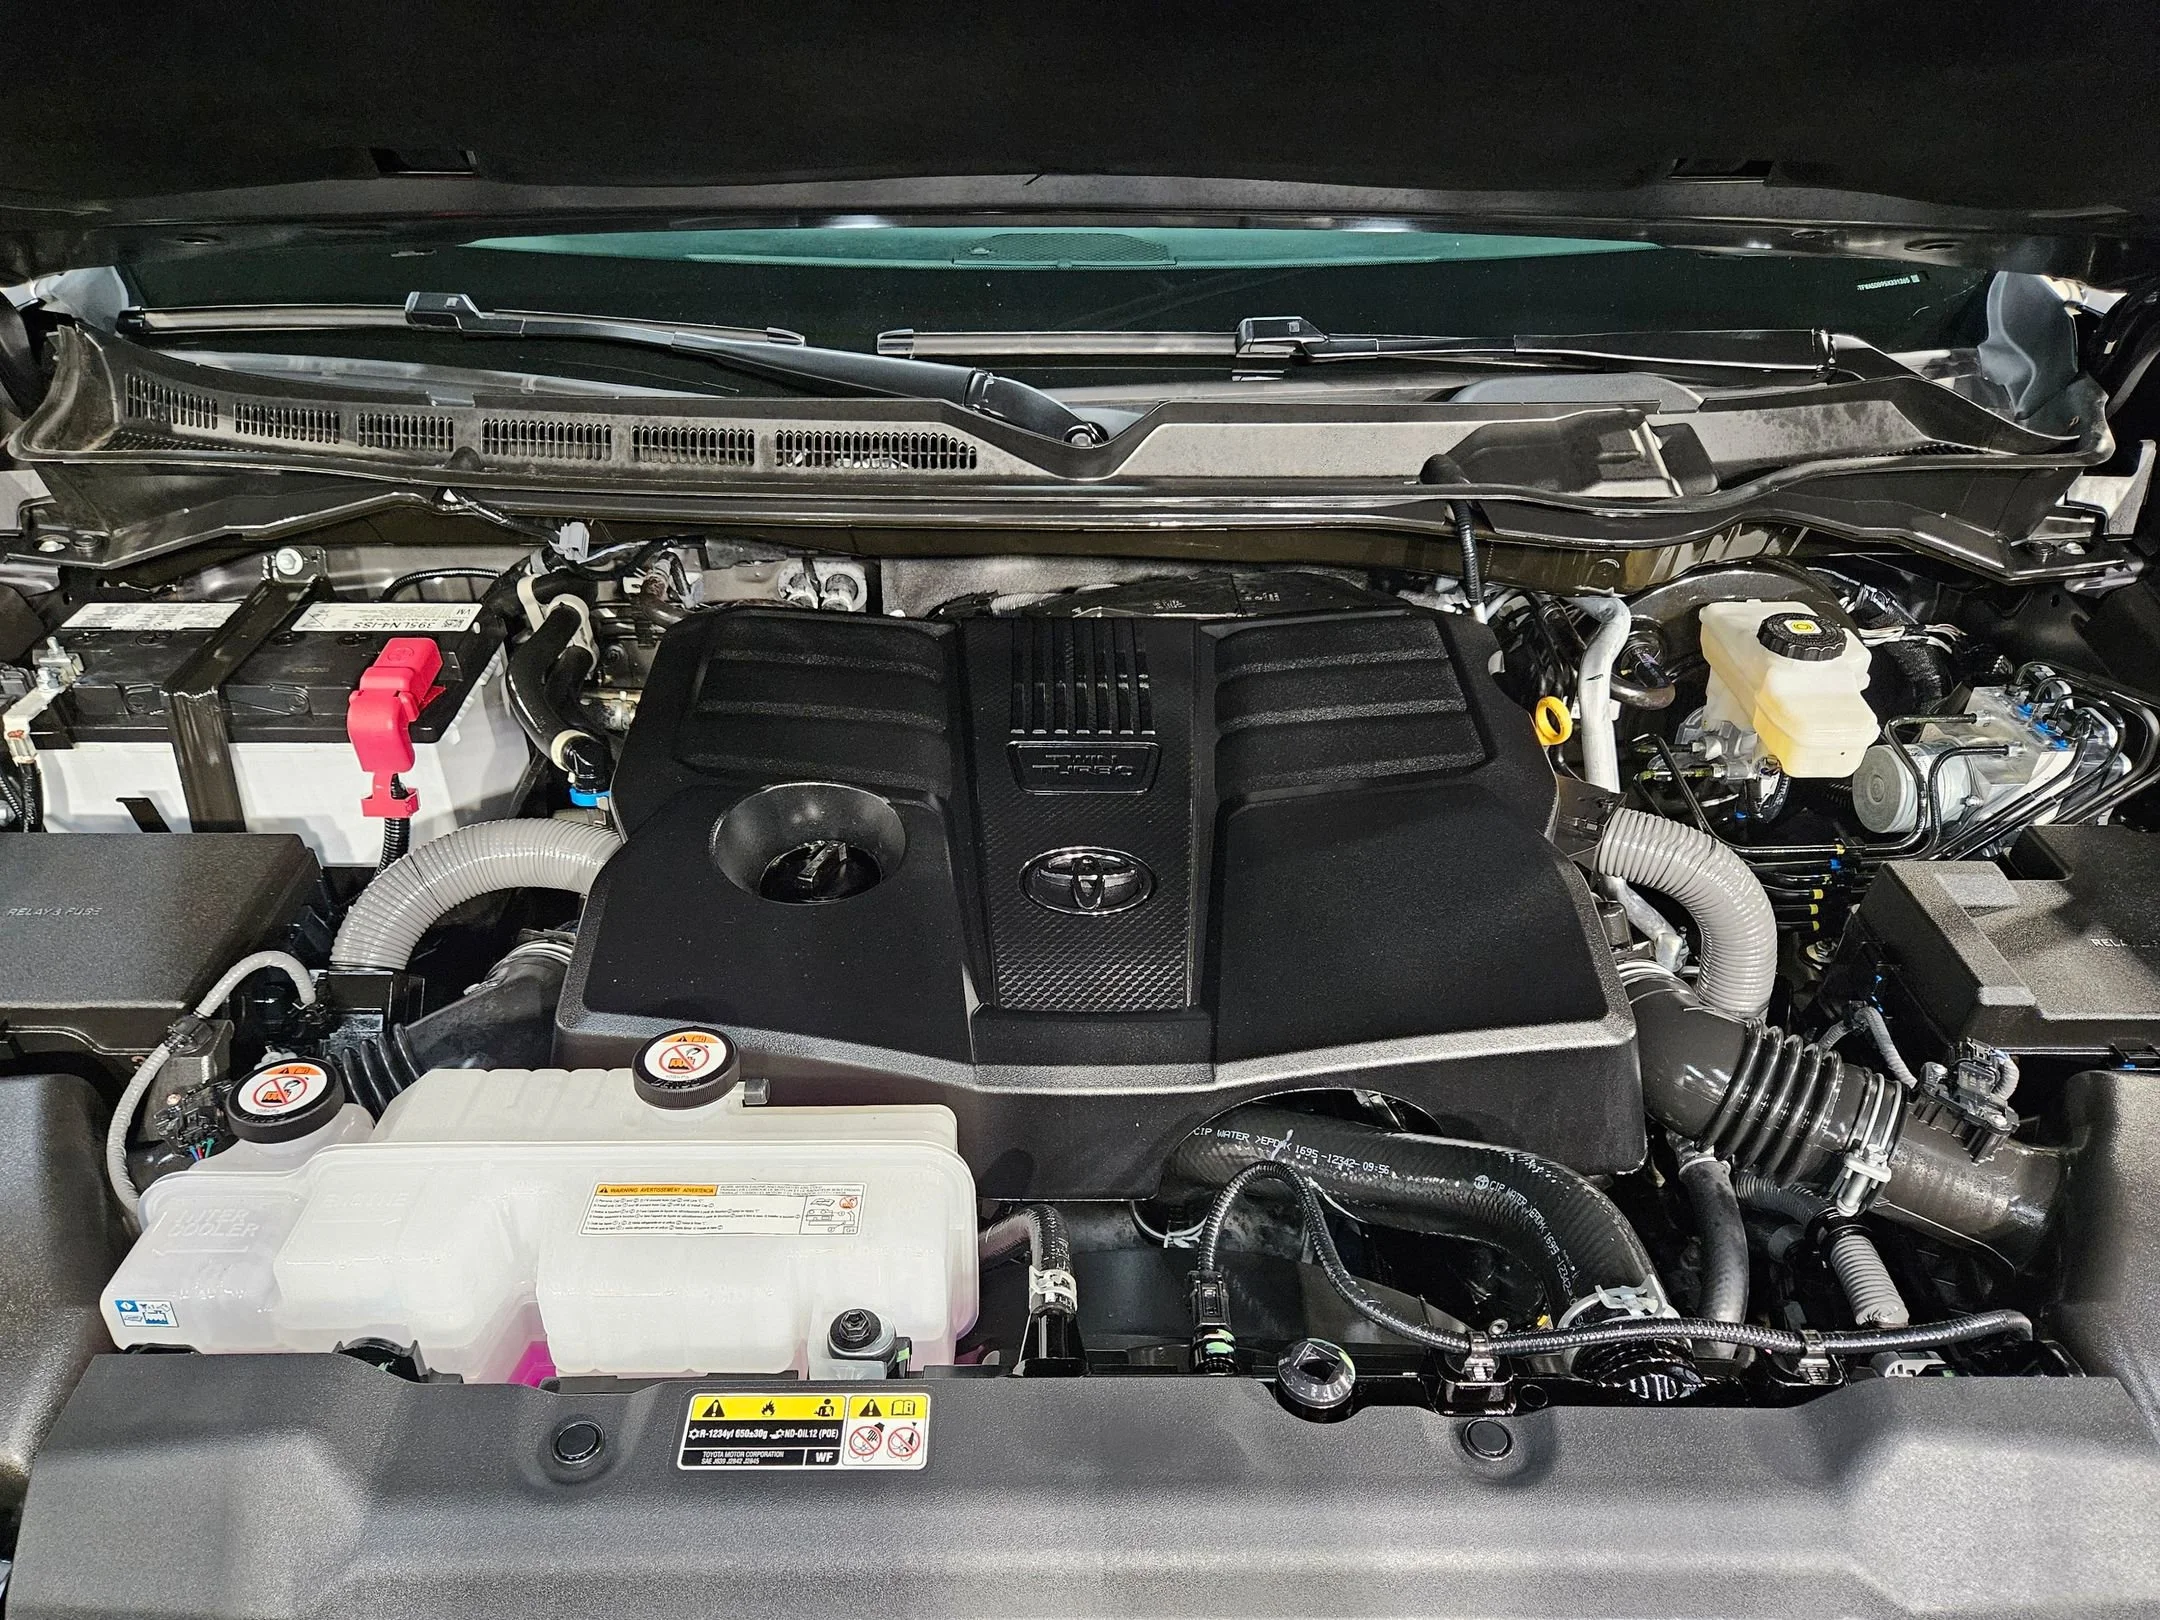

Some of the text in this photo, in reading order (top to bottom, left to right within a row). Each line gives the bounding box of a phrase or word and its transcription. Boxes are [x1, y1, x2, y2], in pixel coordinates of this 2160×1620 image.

[1044, 753, 1117, 764] TWIN
[7, 907, 53, 918] RELAY
[65, 907, 103, 918] FUSE
[1193, 1127, 1213, 1136] CIP
[1216, 1129, 1250, 1142] WATER
[1295, 1144, 1319, 1159] 1695
[1362, 1161, 1391, 1175] 09:56
[1489, 1180, 1506, 1193] CIP
[1505, 1187, 1528, 1208] WATER
[1543, 1231, 1560, 1256] 1695
[167, 1222, 260, 1237] COOLER
[700, 1428, 839, 1440] R-1234yf 650±30g ND-OIL12 (POE)
[702, 1450, 785, 1458] TOYOTA MOTOR CORPORATION
[815, 1451, 833, 1463] WF
